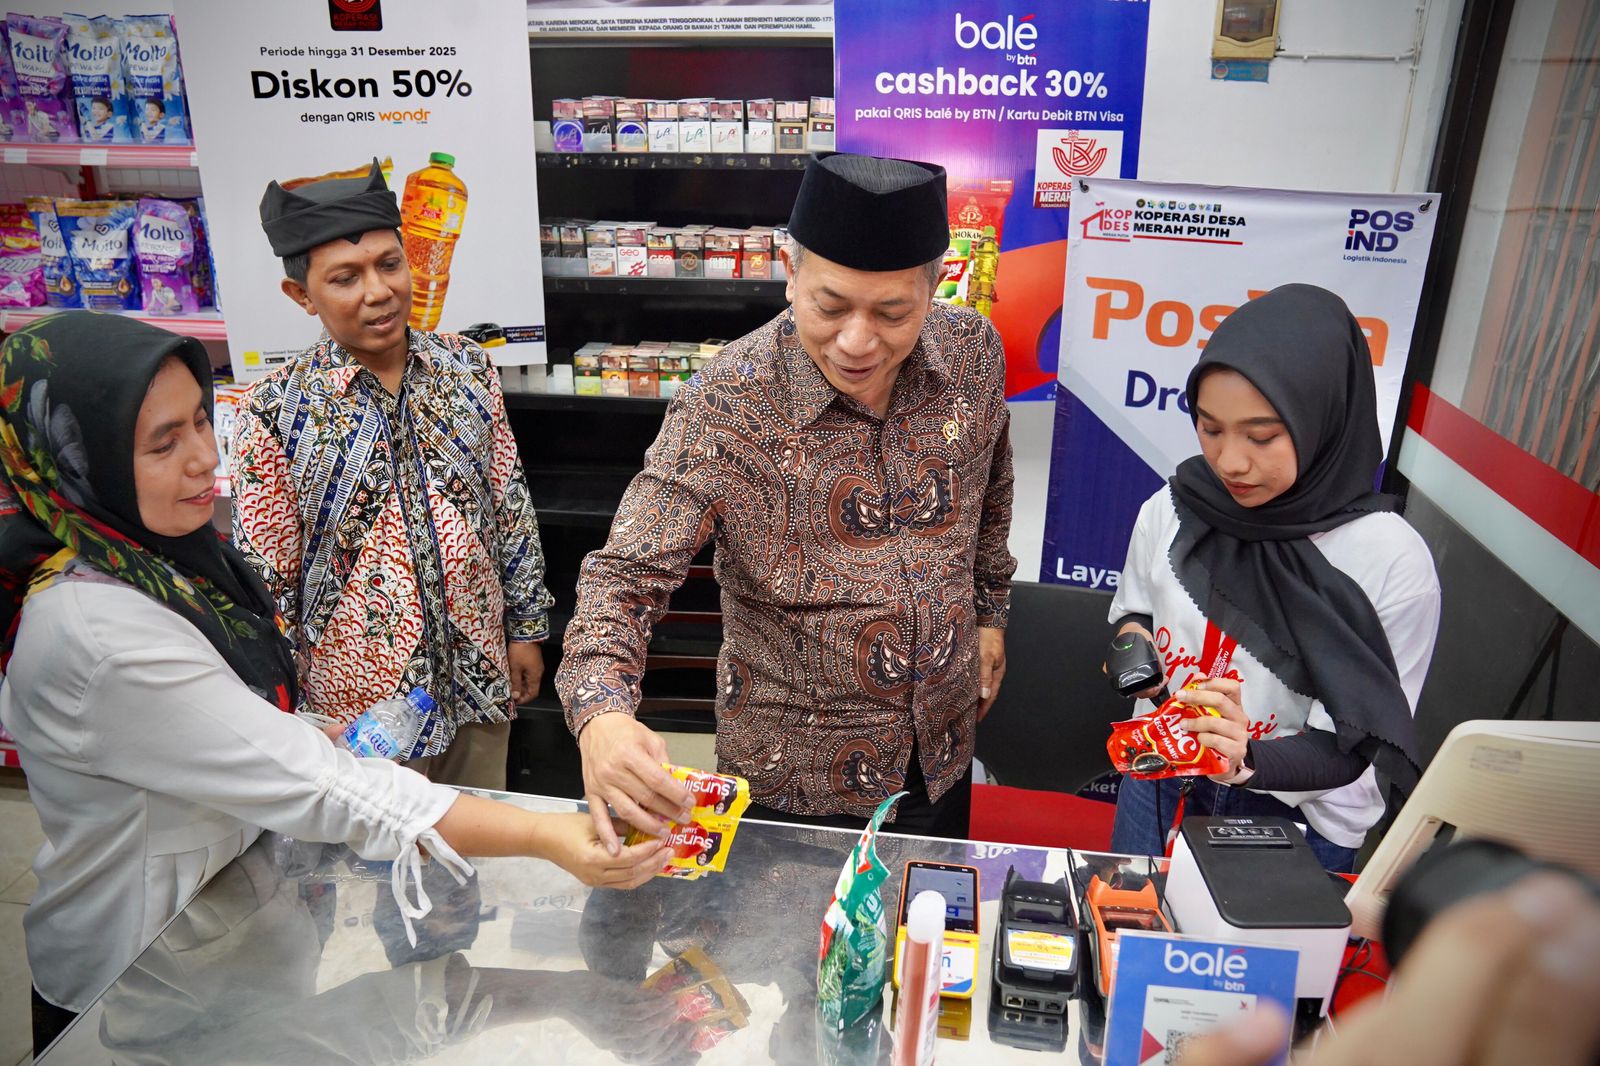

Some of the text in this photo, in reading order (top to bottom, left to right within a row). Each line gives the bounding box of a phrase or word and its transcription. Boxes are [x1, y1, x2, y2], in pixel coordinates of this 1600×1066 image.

[955, 12, 1038, 51] balé
[260, 46, 456, 58] Periode hingga 31 Desember 2025
[1006, 53, 1037, 66] by btn
[250, 68, 473, 99] Diskon 50%
[875, 67, 1108, 99] cashback 30%
[300, 108, 431, 124] dengan QRIS wondr
[855, 106, 1124, 123] pakai QRIS balé by BTN / Kartu Debit BTN Visa
[1037, 182, 1072, 190] KOPERAS
[1104, 209, 1133, 220] KOP
[1135, 210, 1246, 227] KOPERASI DESA
[1348, 208, 1415, 232] POS
[1103, 221, 1130, 231] DES
[1133, 222, 1231, 238] MERAH PUTIH
[40, 234, 64, 249] Molt
[1086, 276, 1389, 367] Posa
[1056, 557, 1121, 589] Laya
[1154, 717, 1167, 736] KECAP
[1162, 713, 1197, 755] ABC
[363, 727, 392, 757] AQUA
[1162, 737, 1179, 760] MANIS
[682, 779, 731, 796] sunsil
[1083, 781, 1118, 794] ket
[664, 834, 714, 850] sunsil
[1164, 942, 1248, 979] balé
[1224, 979, 1246, 992] btn
